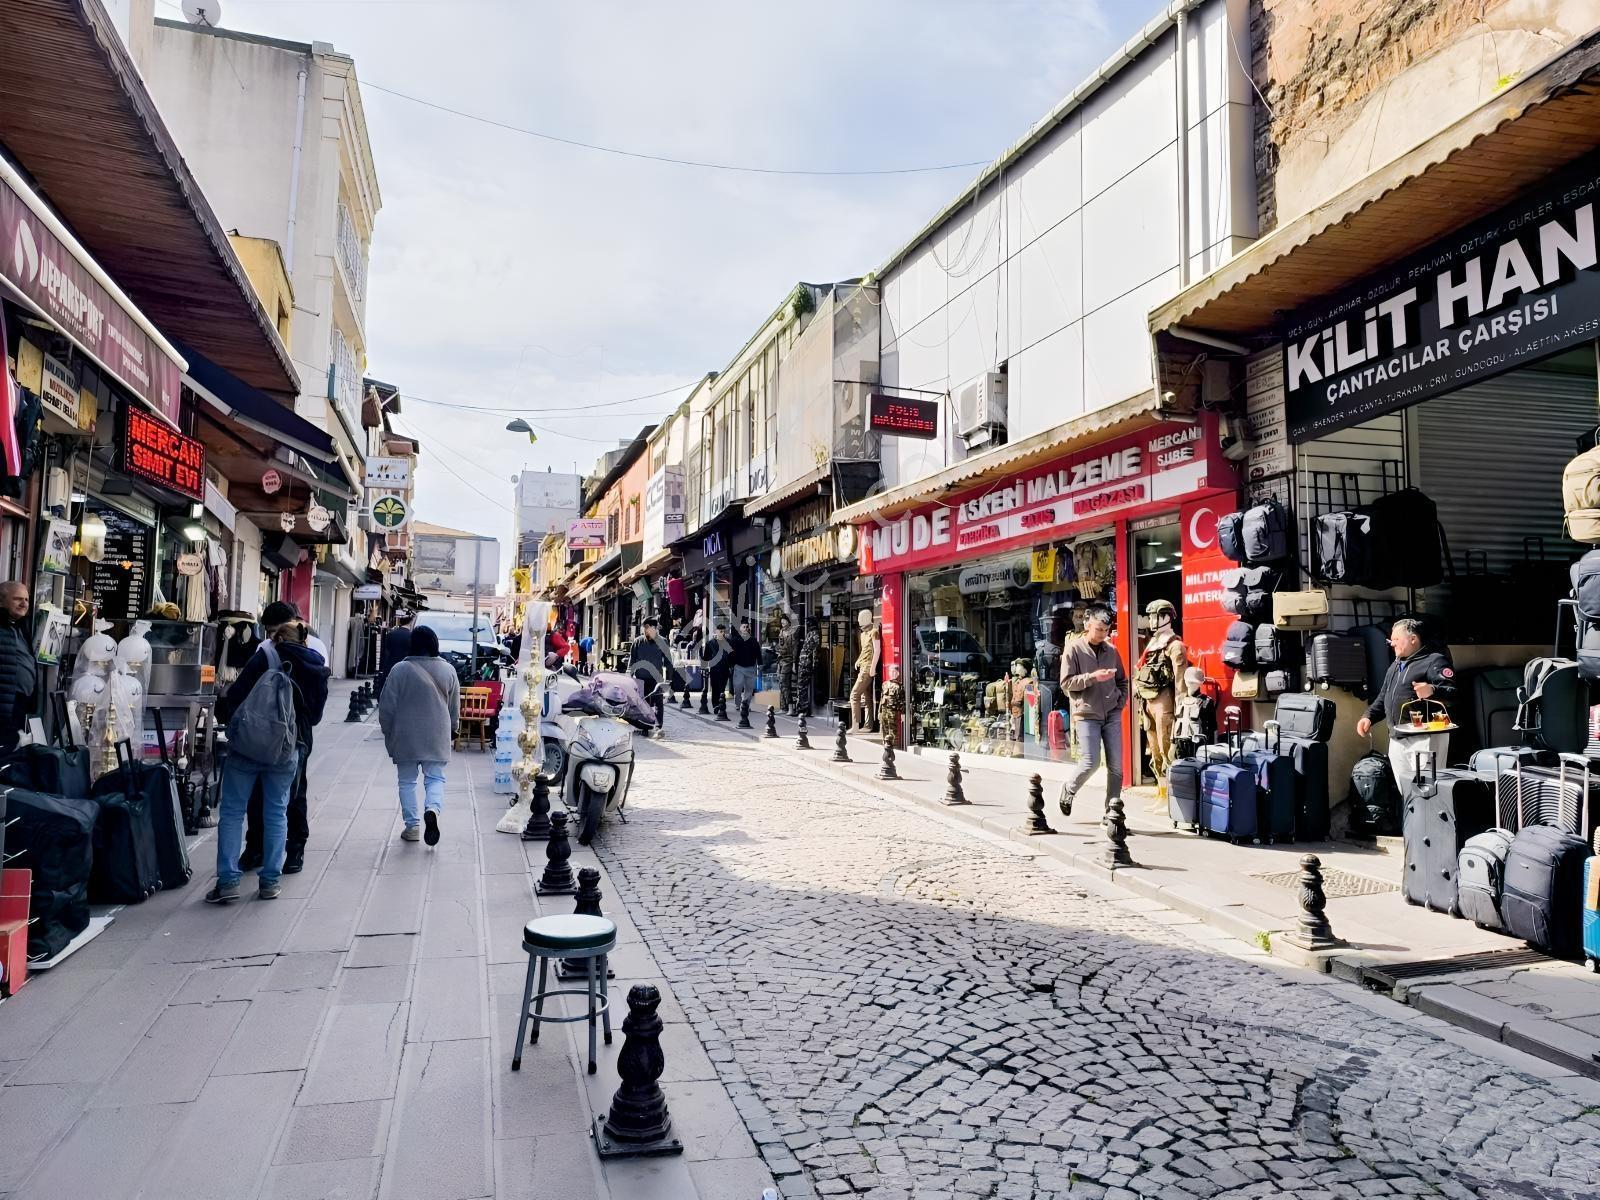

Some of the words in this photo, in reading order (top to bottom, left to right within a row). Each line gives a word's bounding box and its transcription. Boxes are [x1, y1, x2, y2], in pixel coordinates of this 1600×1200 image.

[1437, 202, 1598, 330] HAN
[1326, 338, 1450, 405] ÇANTACILAR
[1458, 294, 1558, 354] ÇARŞISI
[131, 415, 201, 470] MERCAN
[1148, 427, 1202, 453] MERCAN
[1027, 446, 1142, 504] MALZEME
